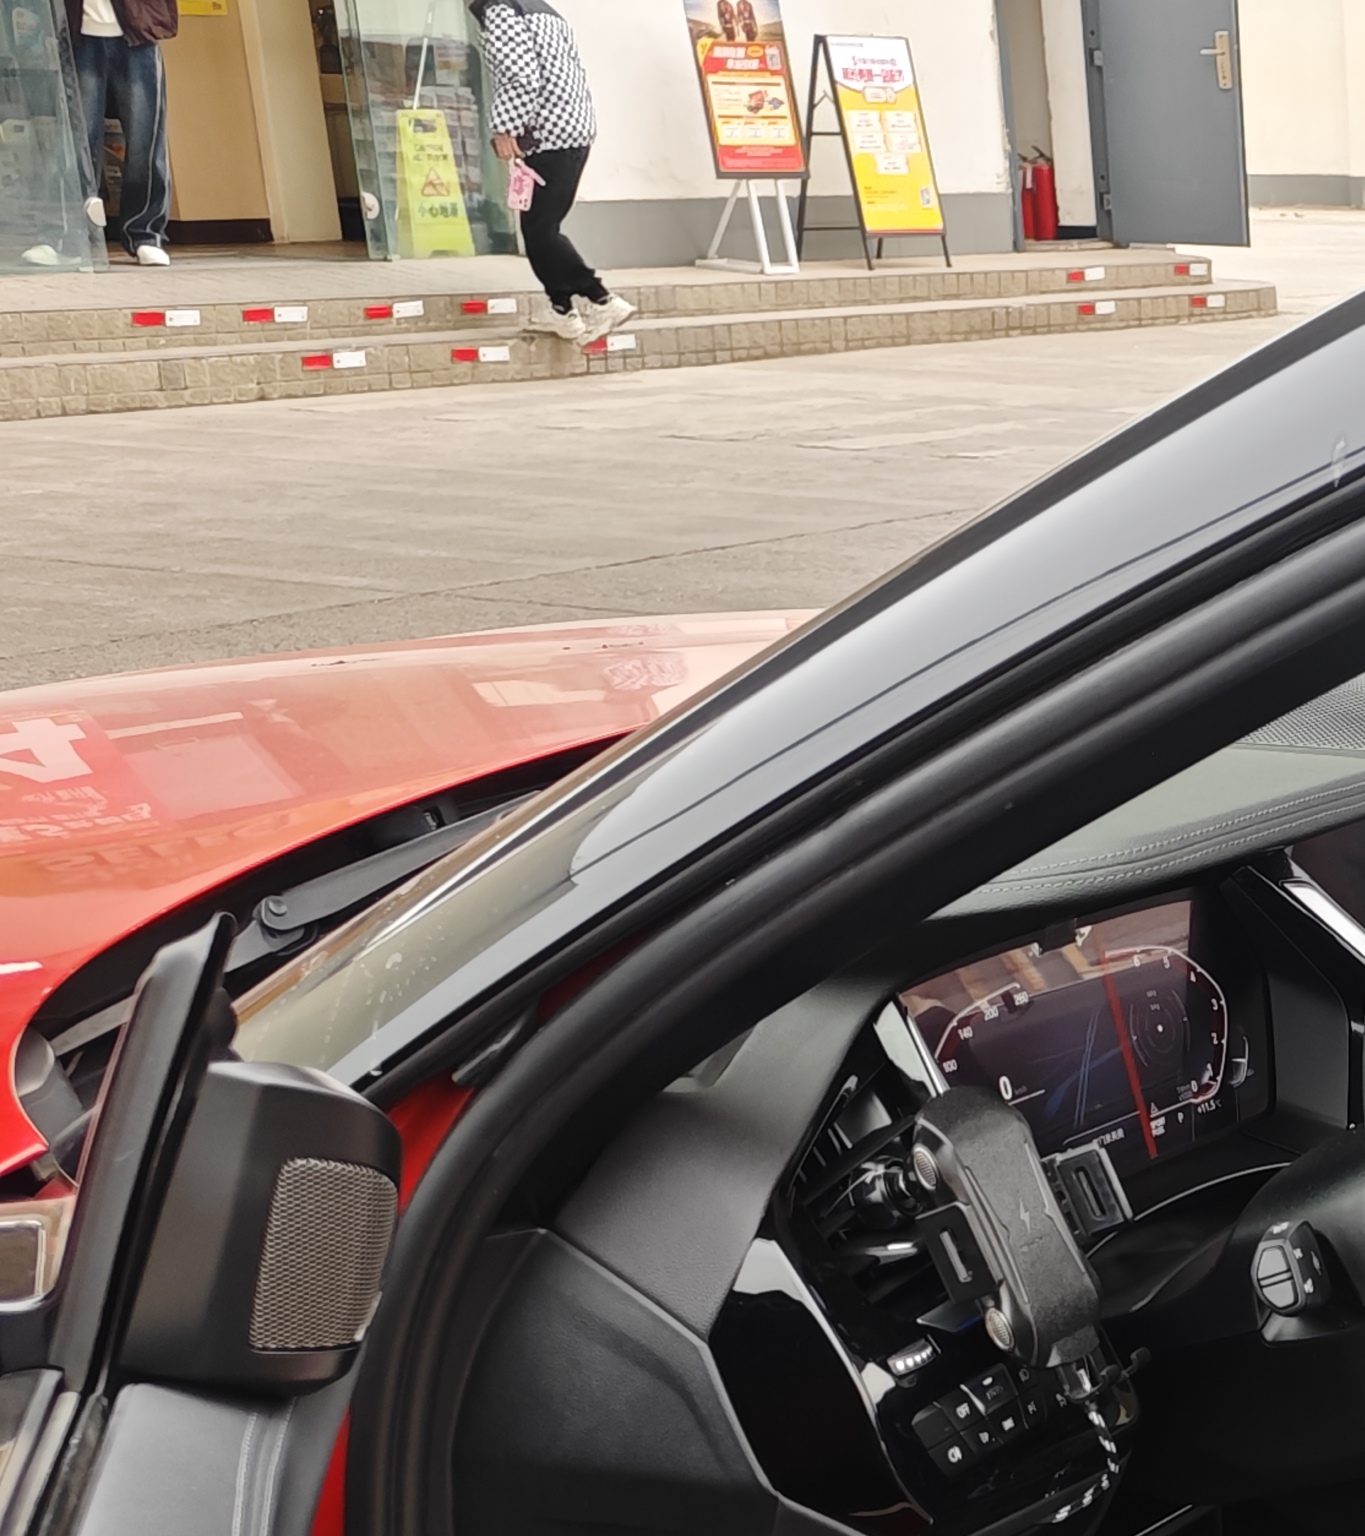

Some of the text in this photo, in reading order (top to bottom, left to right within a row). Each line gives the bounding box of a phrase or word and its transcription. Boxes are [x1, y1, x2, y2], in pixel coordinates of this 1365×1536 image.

[1133, 954, 1141, 967] 6
[1163, 955, 1170, 969] 5
[1190, 971, 1197, 983] 4
[1013, 991, 1029, 1006] 260
[1211, 998, 1218, 1011] 3
[984, 1007, 999, 1021] 200
[957, 1026, 973, 1040] 140
[1211, 1032, 1218, 1045] 2
[942, 1059, 958, 1073] 100
[999, 1075, 1013, 1100] 0
[1191, 1080, 1198, 1093] 0
